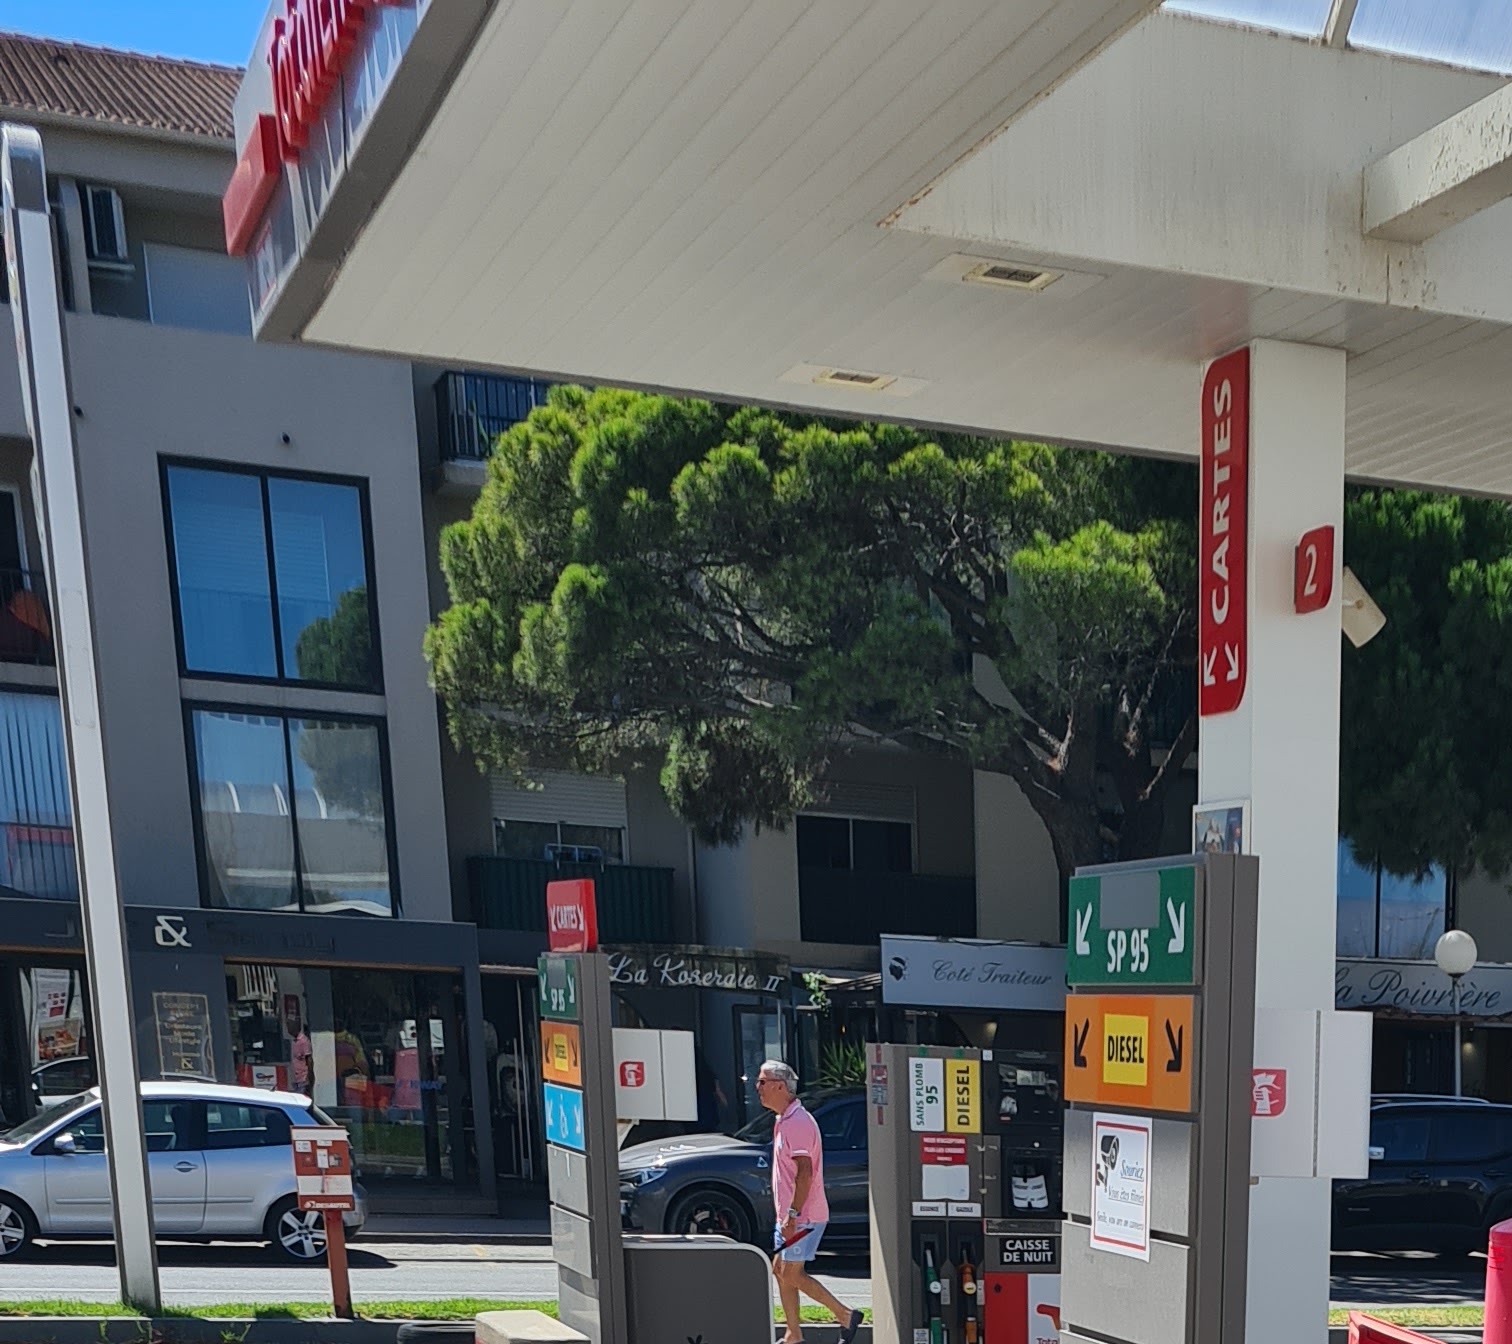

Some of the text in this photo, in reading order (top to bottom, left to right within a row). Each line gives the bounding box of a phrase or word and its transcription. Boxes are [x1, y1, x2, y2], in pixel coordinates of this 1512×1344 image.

[1211, 377, 1233, 625] CARTES
[1303, 543, 1317, 597] 2
[155, 915, 192, 947] &
[557, 904, 578, 929] CARTES
[1107, 928, 1149, 973] SP 95
[607, 952, 648, 984] La
[977, 961, 1053, 985] Traiteur
[1107, 1035, 1145, 1064] DIESEL
[914, 1062, 924, 1126] SANS PLOMB
[925, 1084, 939, 1105] 95
[956, 1065, 971, 1126] DIESEL
[1120, 1159, 1144, 1180] Souriez
[1003, 1252, 1053, 1263] DE NUIT
[1005, 1239, 1050, 1251] CAISSE
